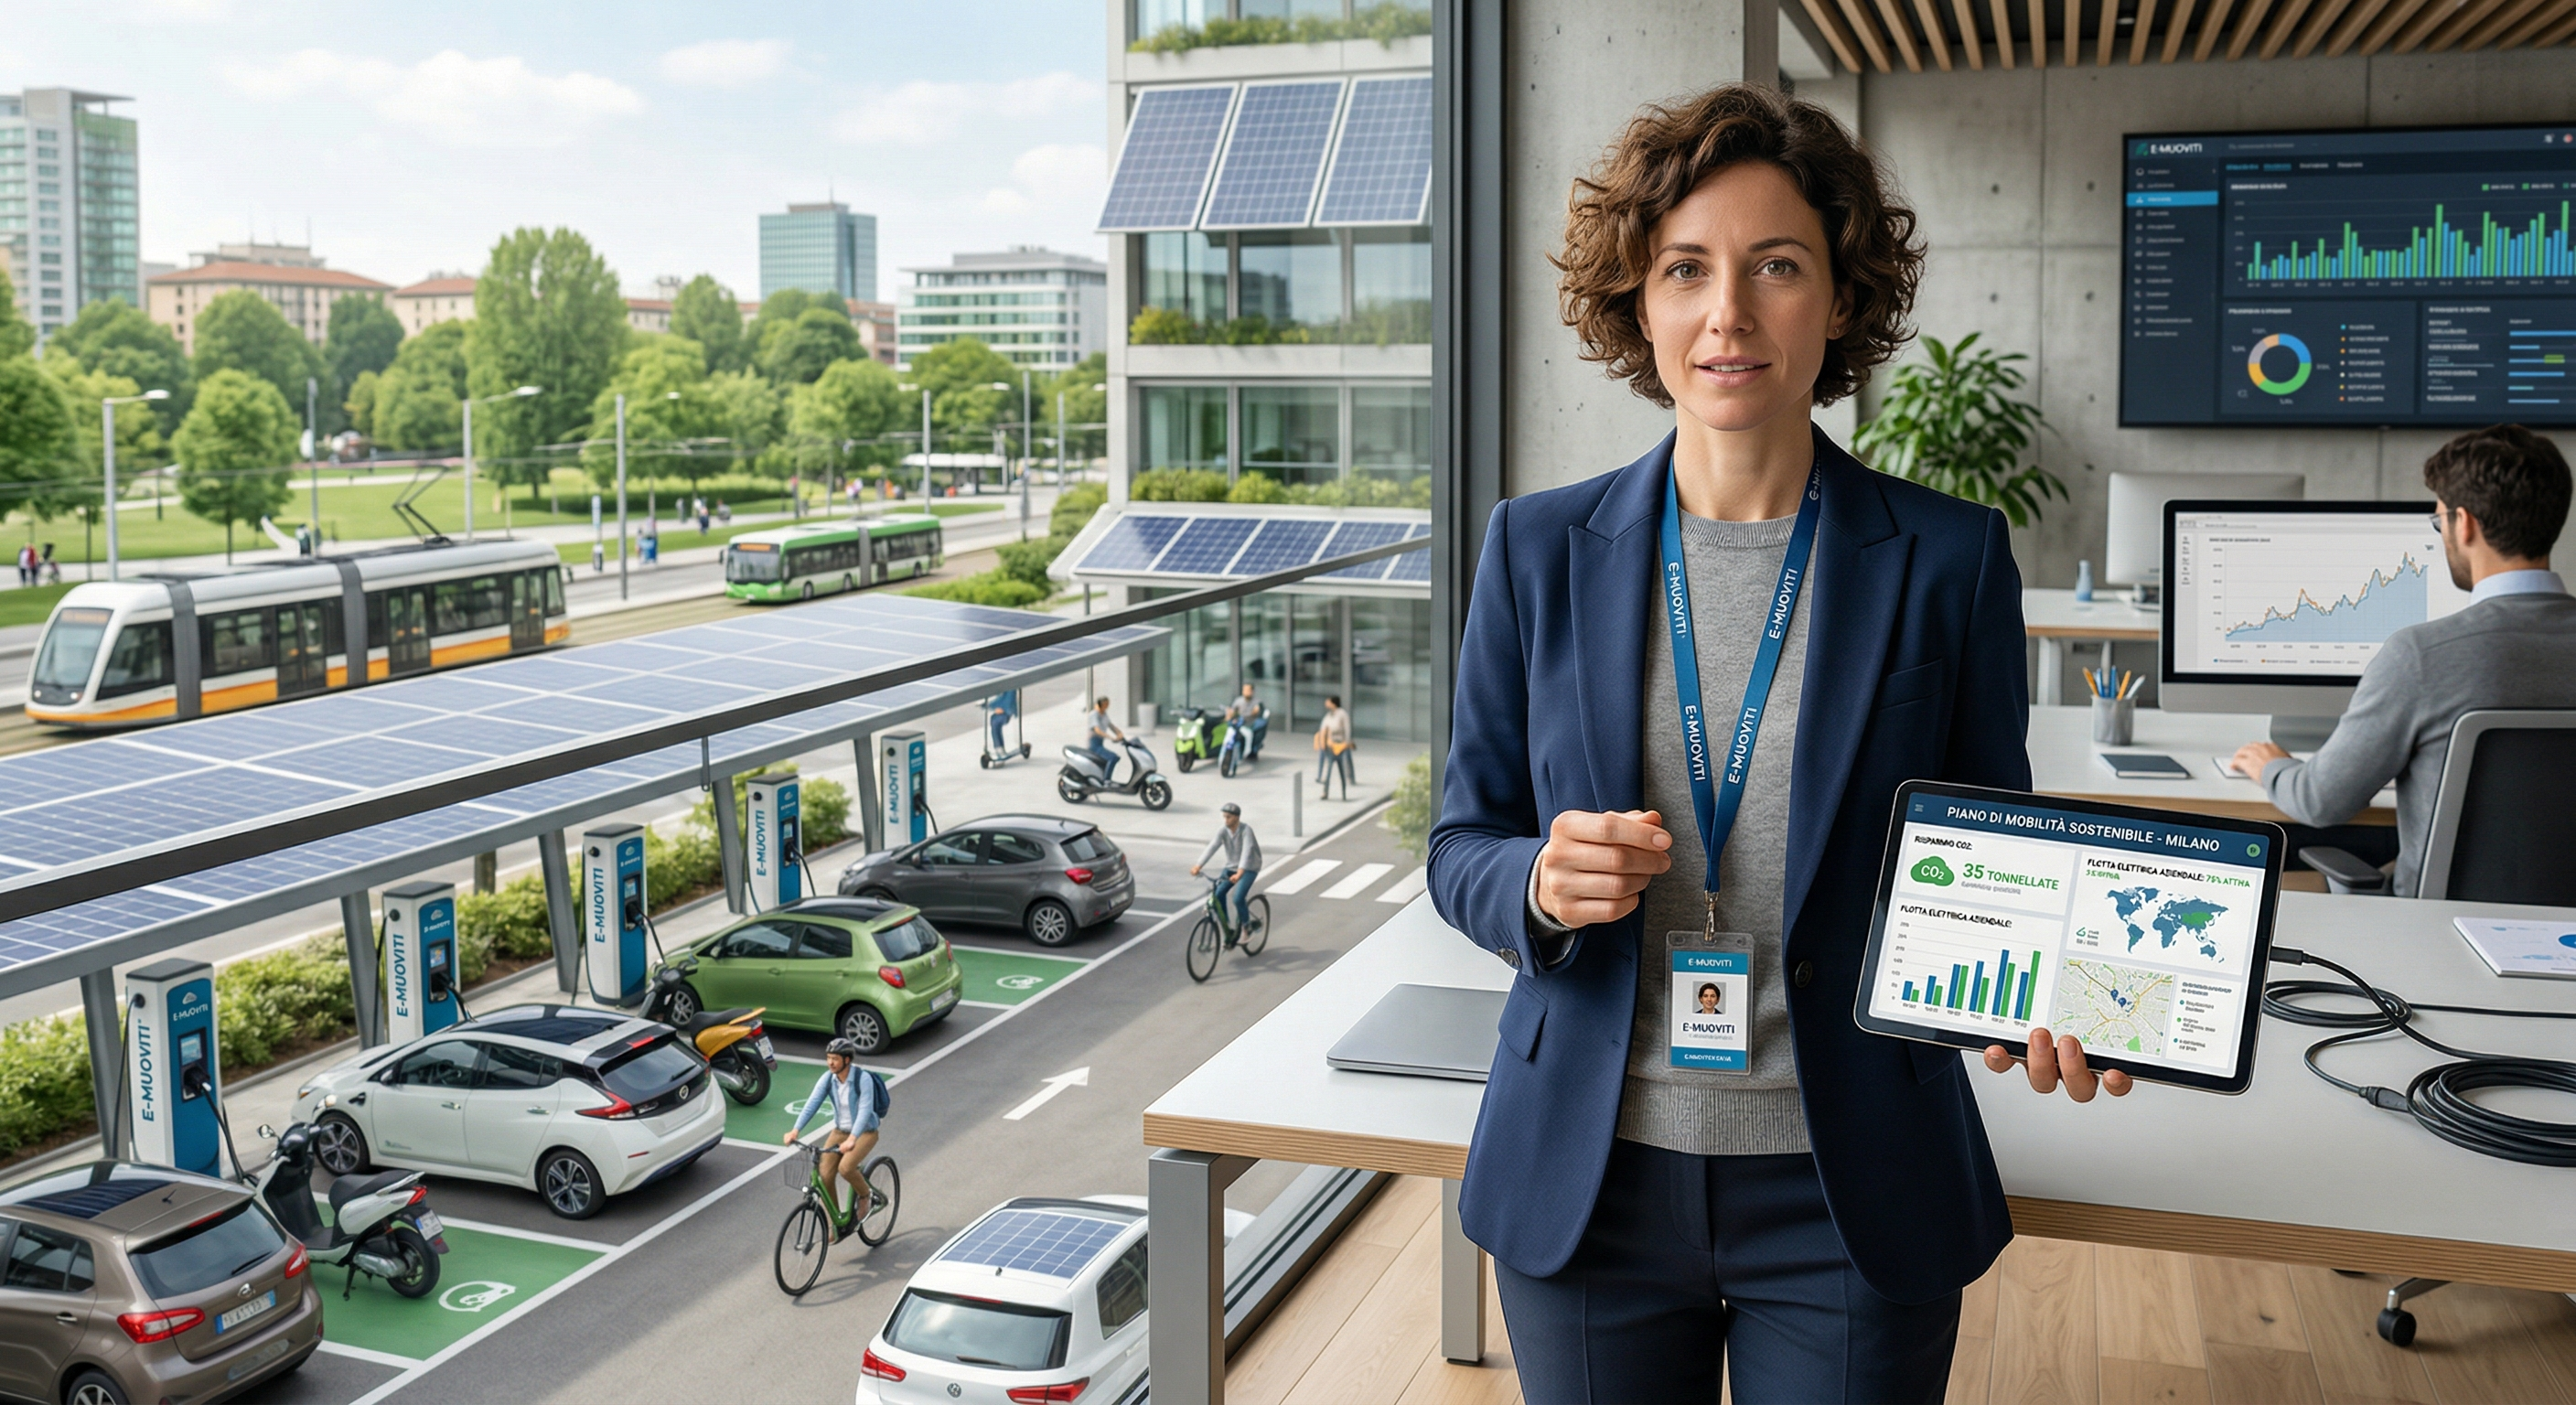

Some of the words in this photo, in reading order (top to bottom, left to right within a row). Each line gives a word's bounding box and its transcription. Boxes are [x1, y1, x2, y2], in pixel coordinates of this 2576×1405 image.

[1668, 562, 1687, 634] E-MUOVITI
[1768, 568, 1798, 639] E-MUOVITI
[1728, 707, 1757, 784] E-MUOVITI
[755, 810, 767, 876] E-MUOVITI
[1947, 806, 1987, 822] PIANO
[1989, 812, 2002, 823] DI
[2004, 814, 2066, 832] MOBILITÀ
[2068, 821, 2154, 843] SOSTENIBILE
[2165, 834, 2220, 852] MILANO
[593, 868, 606, 943] E-MUOVITI
[1962, 863, 1985, 879] 35
[1987, 870, 2060, 890] TONNELLATE
[393, 934, 408, 1017] E-MUOVITI
[1682, 1022, 1735, 1034] E-MUOVITI
[137, 1025, 154, 1121] E-MUOVITI
